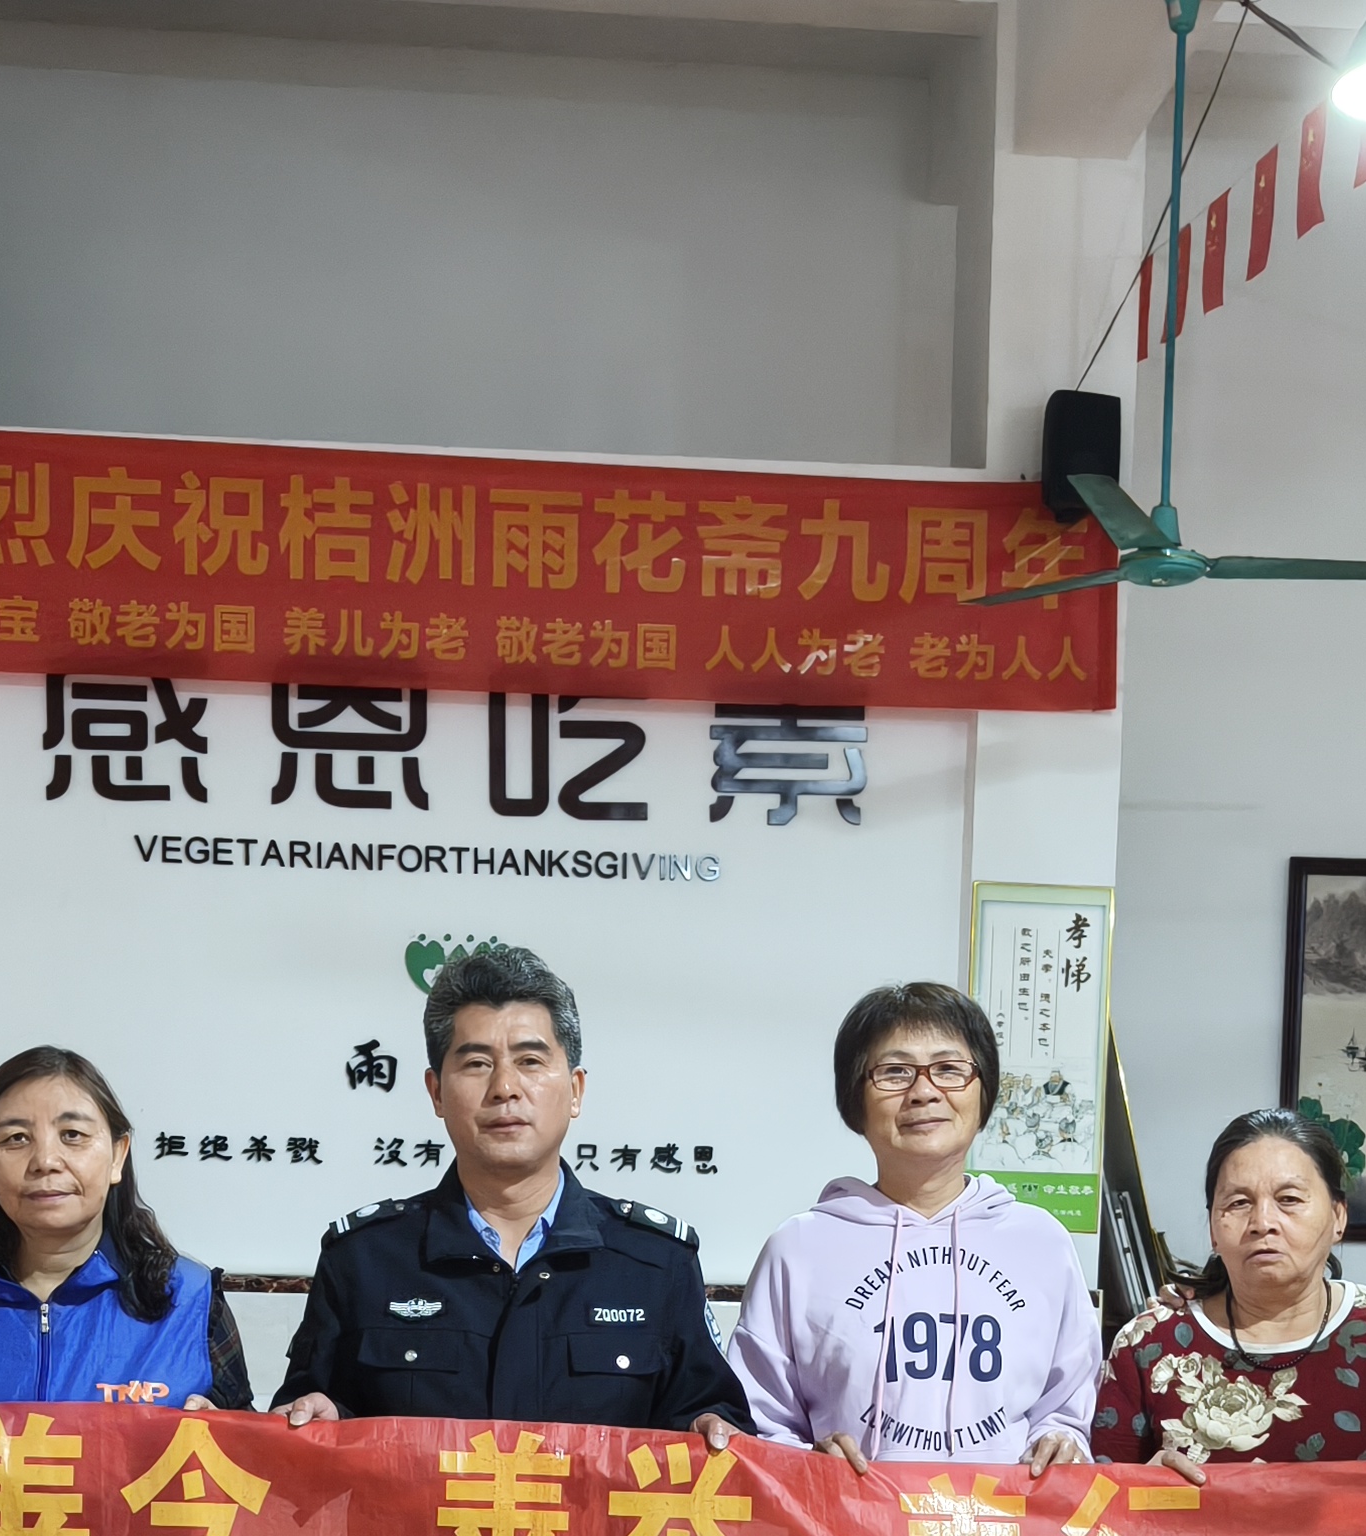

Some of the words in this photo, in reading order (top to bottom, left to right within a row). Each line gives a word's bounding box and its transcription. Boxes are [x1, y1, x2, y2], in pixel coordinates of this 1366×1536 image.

[68, 598, 256, 654] 敬老为国
[284, 607, 469, 661] 养儿为老
[495, 616, 677, 671] 敬老为国
[705, 624, 885, 679] 人人为老
[909, 634, 1088, 682] 老为人人
[134, 834, 721, 882] VEGETARIANFORTHANKSGIVING
[1062, 912, 1091, 992] 孝悌
[346, 1039, 398, 1093] 雨
[154, 1131, 323, 1165] 拒绝杀戮
[575, 1143, 718, 1175] 只有感恩
[593, 1307, 646, 1322] ZQ0072
[988, 1270, 1027, 1312] FEAR
[874, 1311, 1004, 1383] 1978
[970, 1405, 1009, 1445] LIMIT
